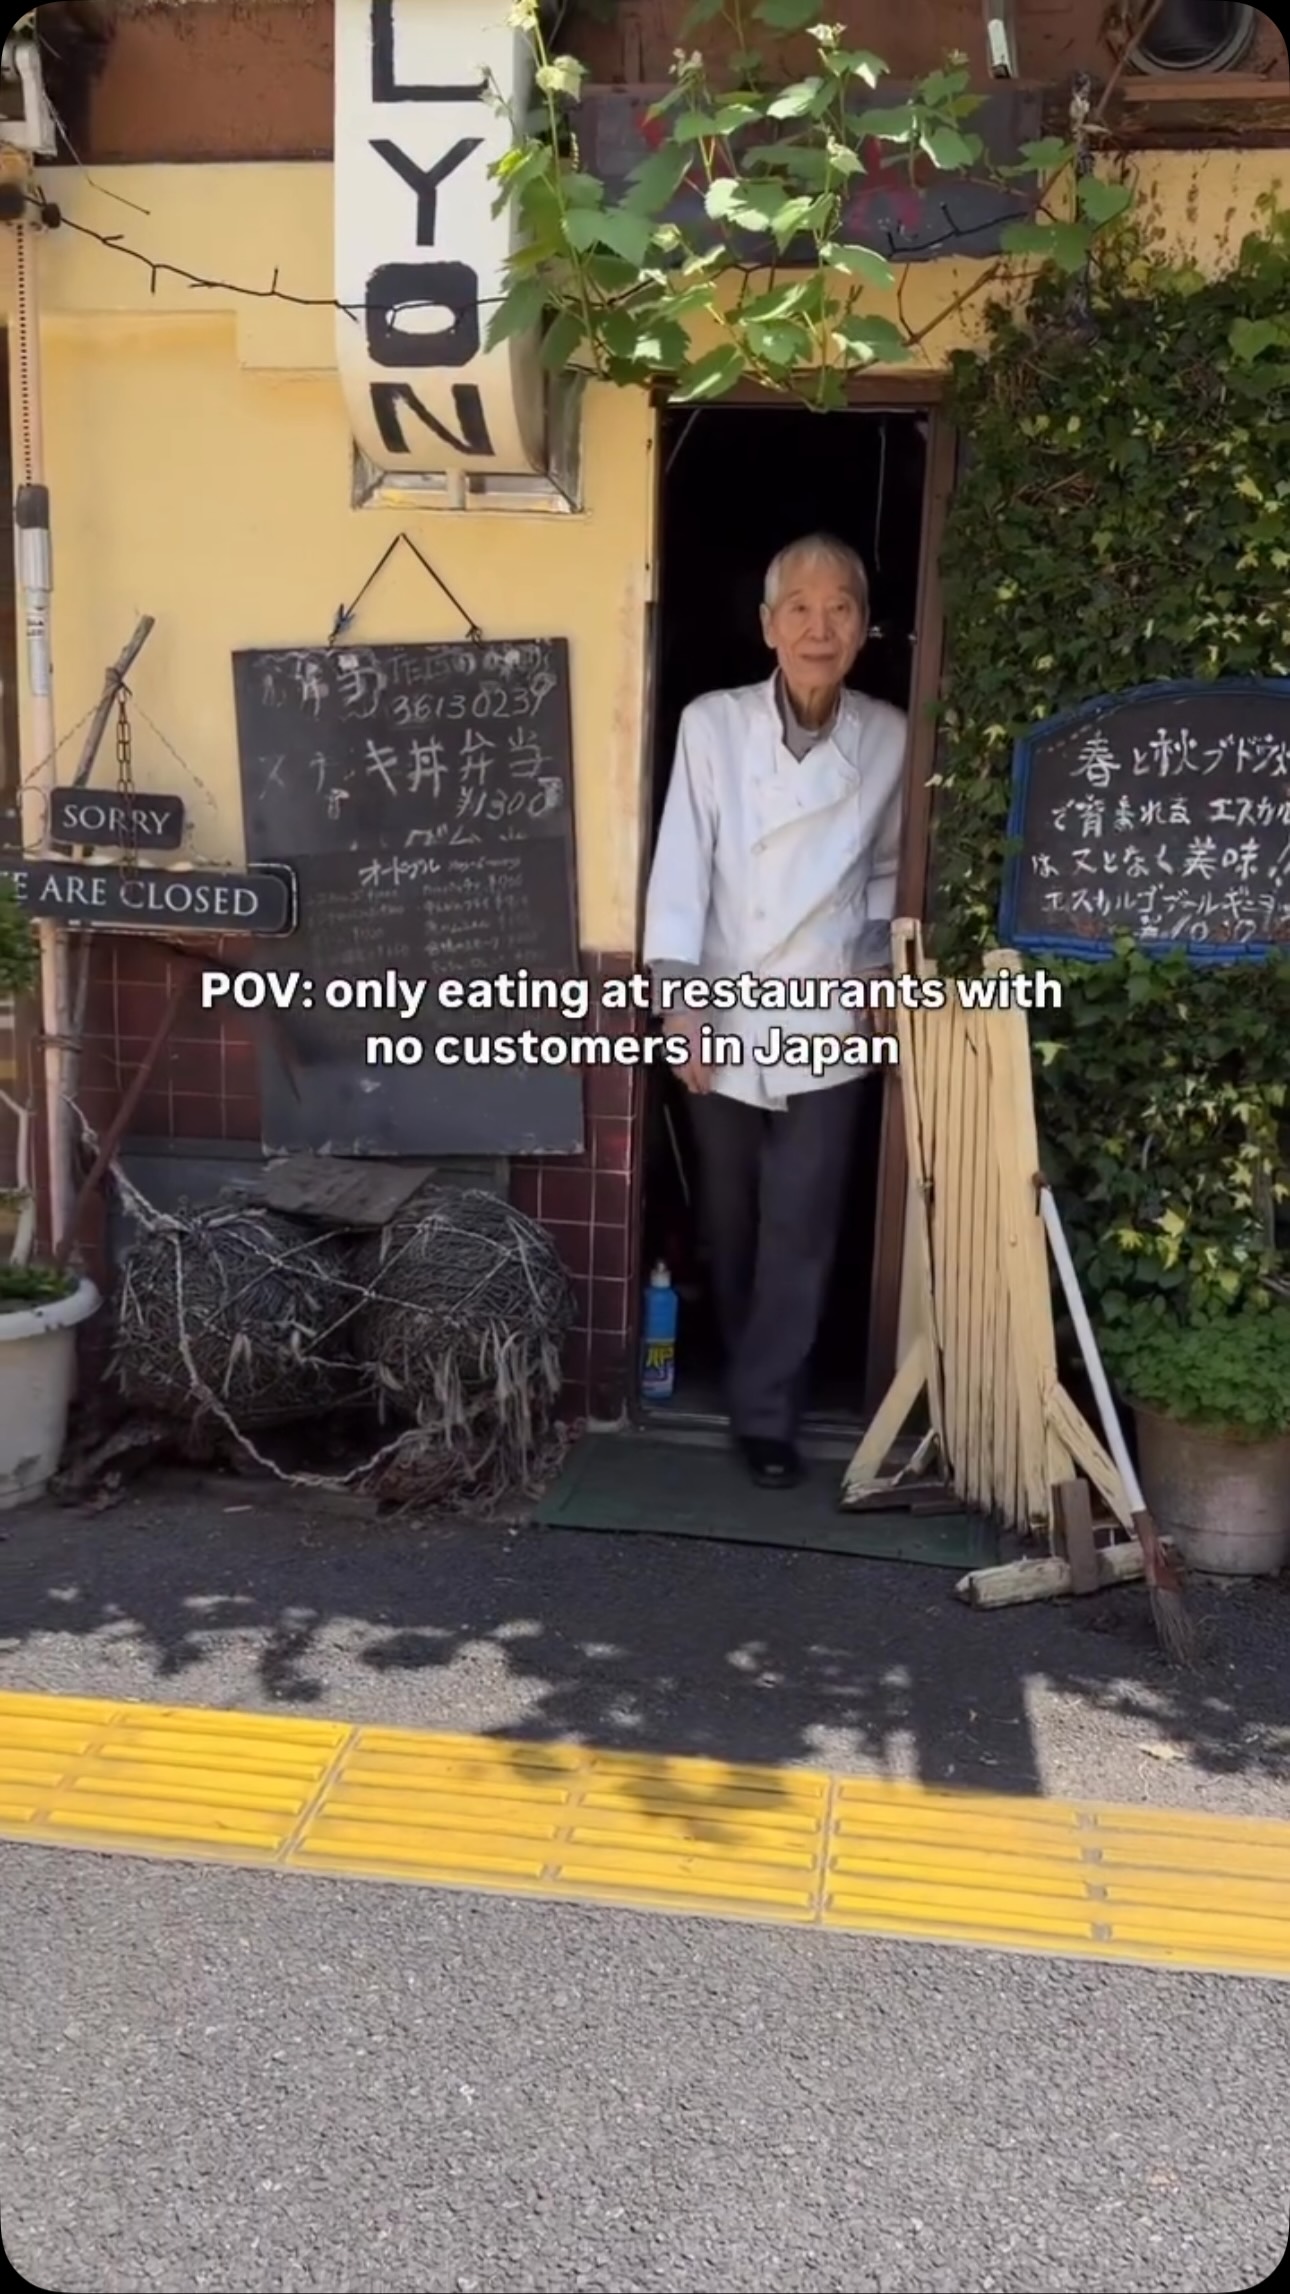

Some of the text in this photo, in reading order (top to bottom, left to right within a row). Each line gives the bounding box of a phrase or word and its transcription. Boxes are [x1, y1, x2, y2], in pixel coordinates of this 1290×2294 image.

[364, 0, 495, 456] LYON
[62, 803, 171, 835] SORRY
[40, 875, 107, 906] ARE
[119, 880, 259, 916] CLOSED
